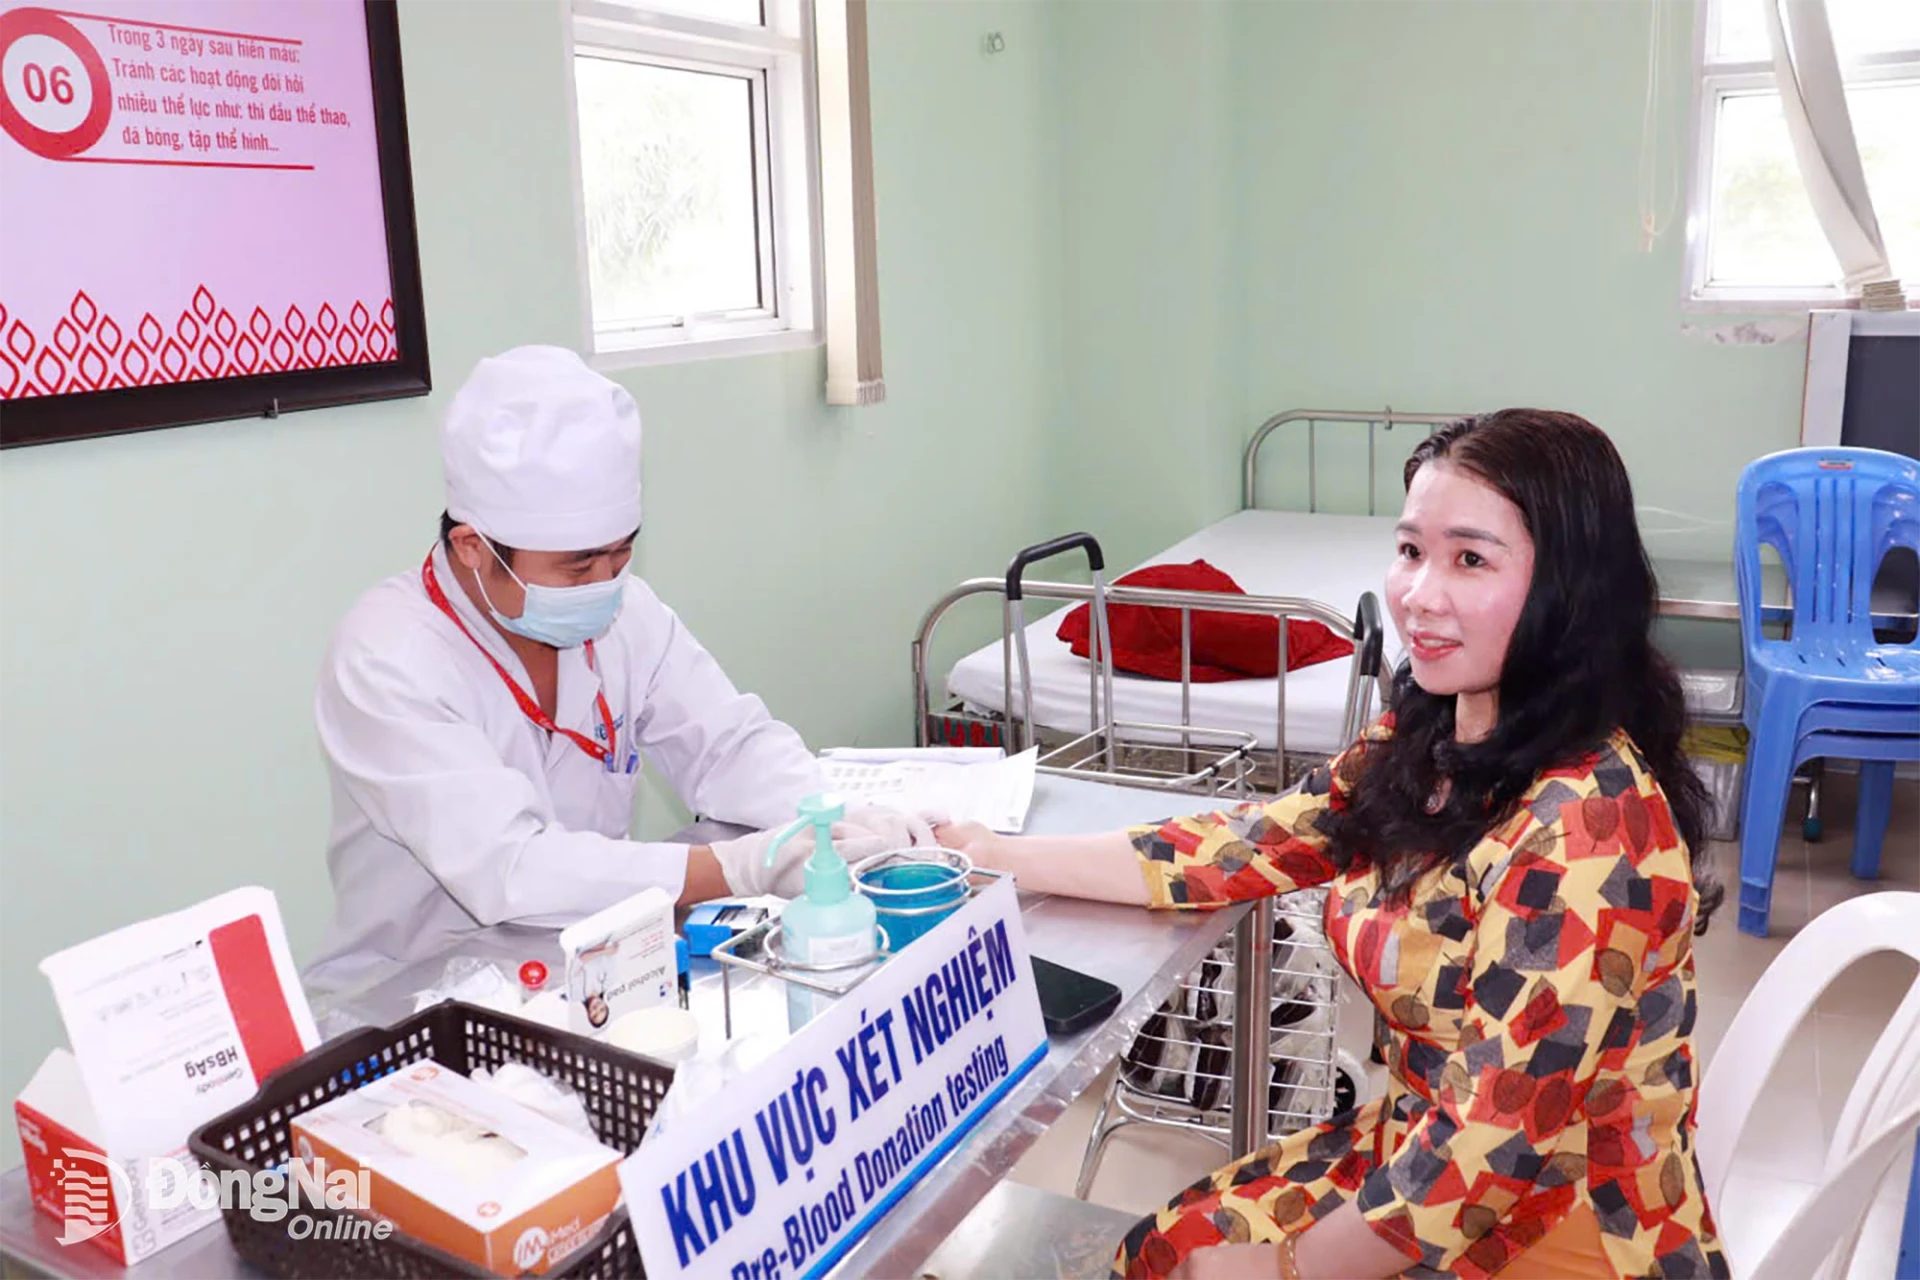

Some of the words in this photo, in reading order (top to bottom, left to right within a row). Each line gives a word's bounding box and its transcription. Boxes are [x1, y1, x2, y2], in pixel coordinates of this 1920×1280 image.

[108, 24, 152, 51] Trong
[155, 30, 165, 48] 3
[170, 33, 203, 57] ngày
[208, 39, 233, 56] sau
[22, 63, 74, 105] 06
[111, 57, 155, 80] Tránh
[160, 64, 186, 83] các
[189, 66, 222, 89] hoạt
[225, 70, 259, 93] động
[262, 73, 281, 91] đòi
[285, 73, 304, 93] hỏi
[118, 91, 157, 113] nhiều
[162, 92, 185, 115] thể
[190, 97, 211, 119] lực
[248, 102, 265, 120] thi
[296, 102, 316, 123] thể
[320, 107, 351, 127] thao,
[122, 126, 140, 144] đá
[145, 126, 184, 151] bóng,
[188, 129, 211, 152] tập
[215, 127, 237, 149] thể
[607, 983, 626, 1002] pad
[628, 965, 666, 990] Alcohol
[184, 1045, 238, 1079] HBsAg
[660, 1128, 756, 1268] KHU
[756, 1066, 837, 1182] VỰC
[836, 1007, 903, 1122] XÉT
[902, 917, 1017, 1065] NGHIỆM
[855, 1092, 948, 1204] Donation
[947, 1034, 1010, 1116] testing
